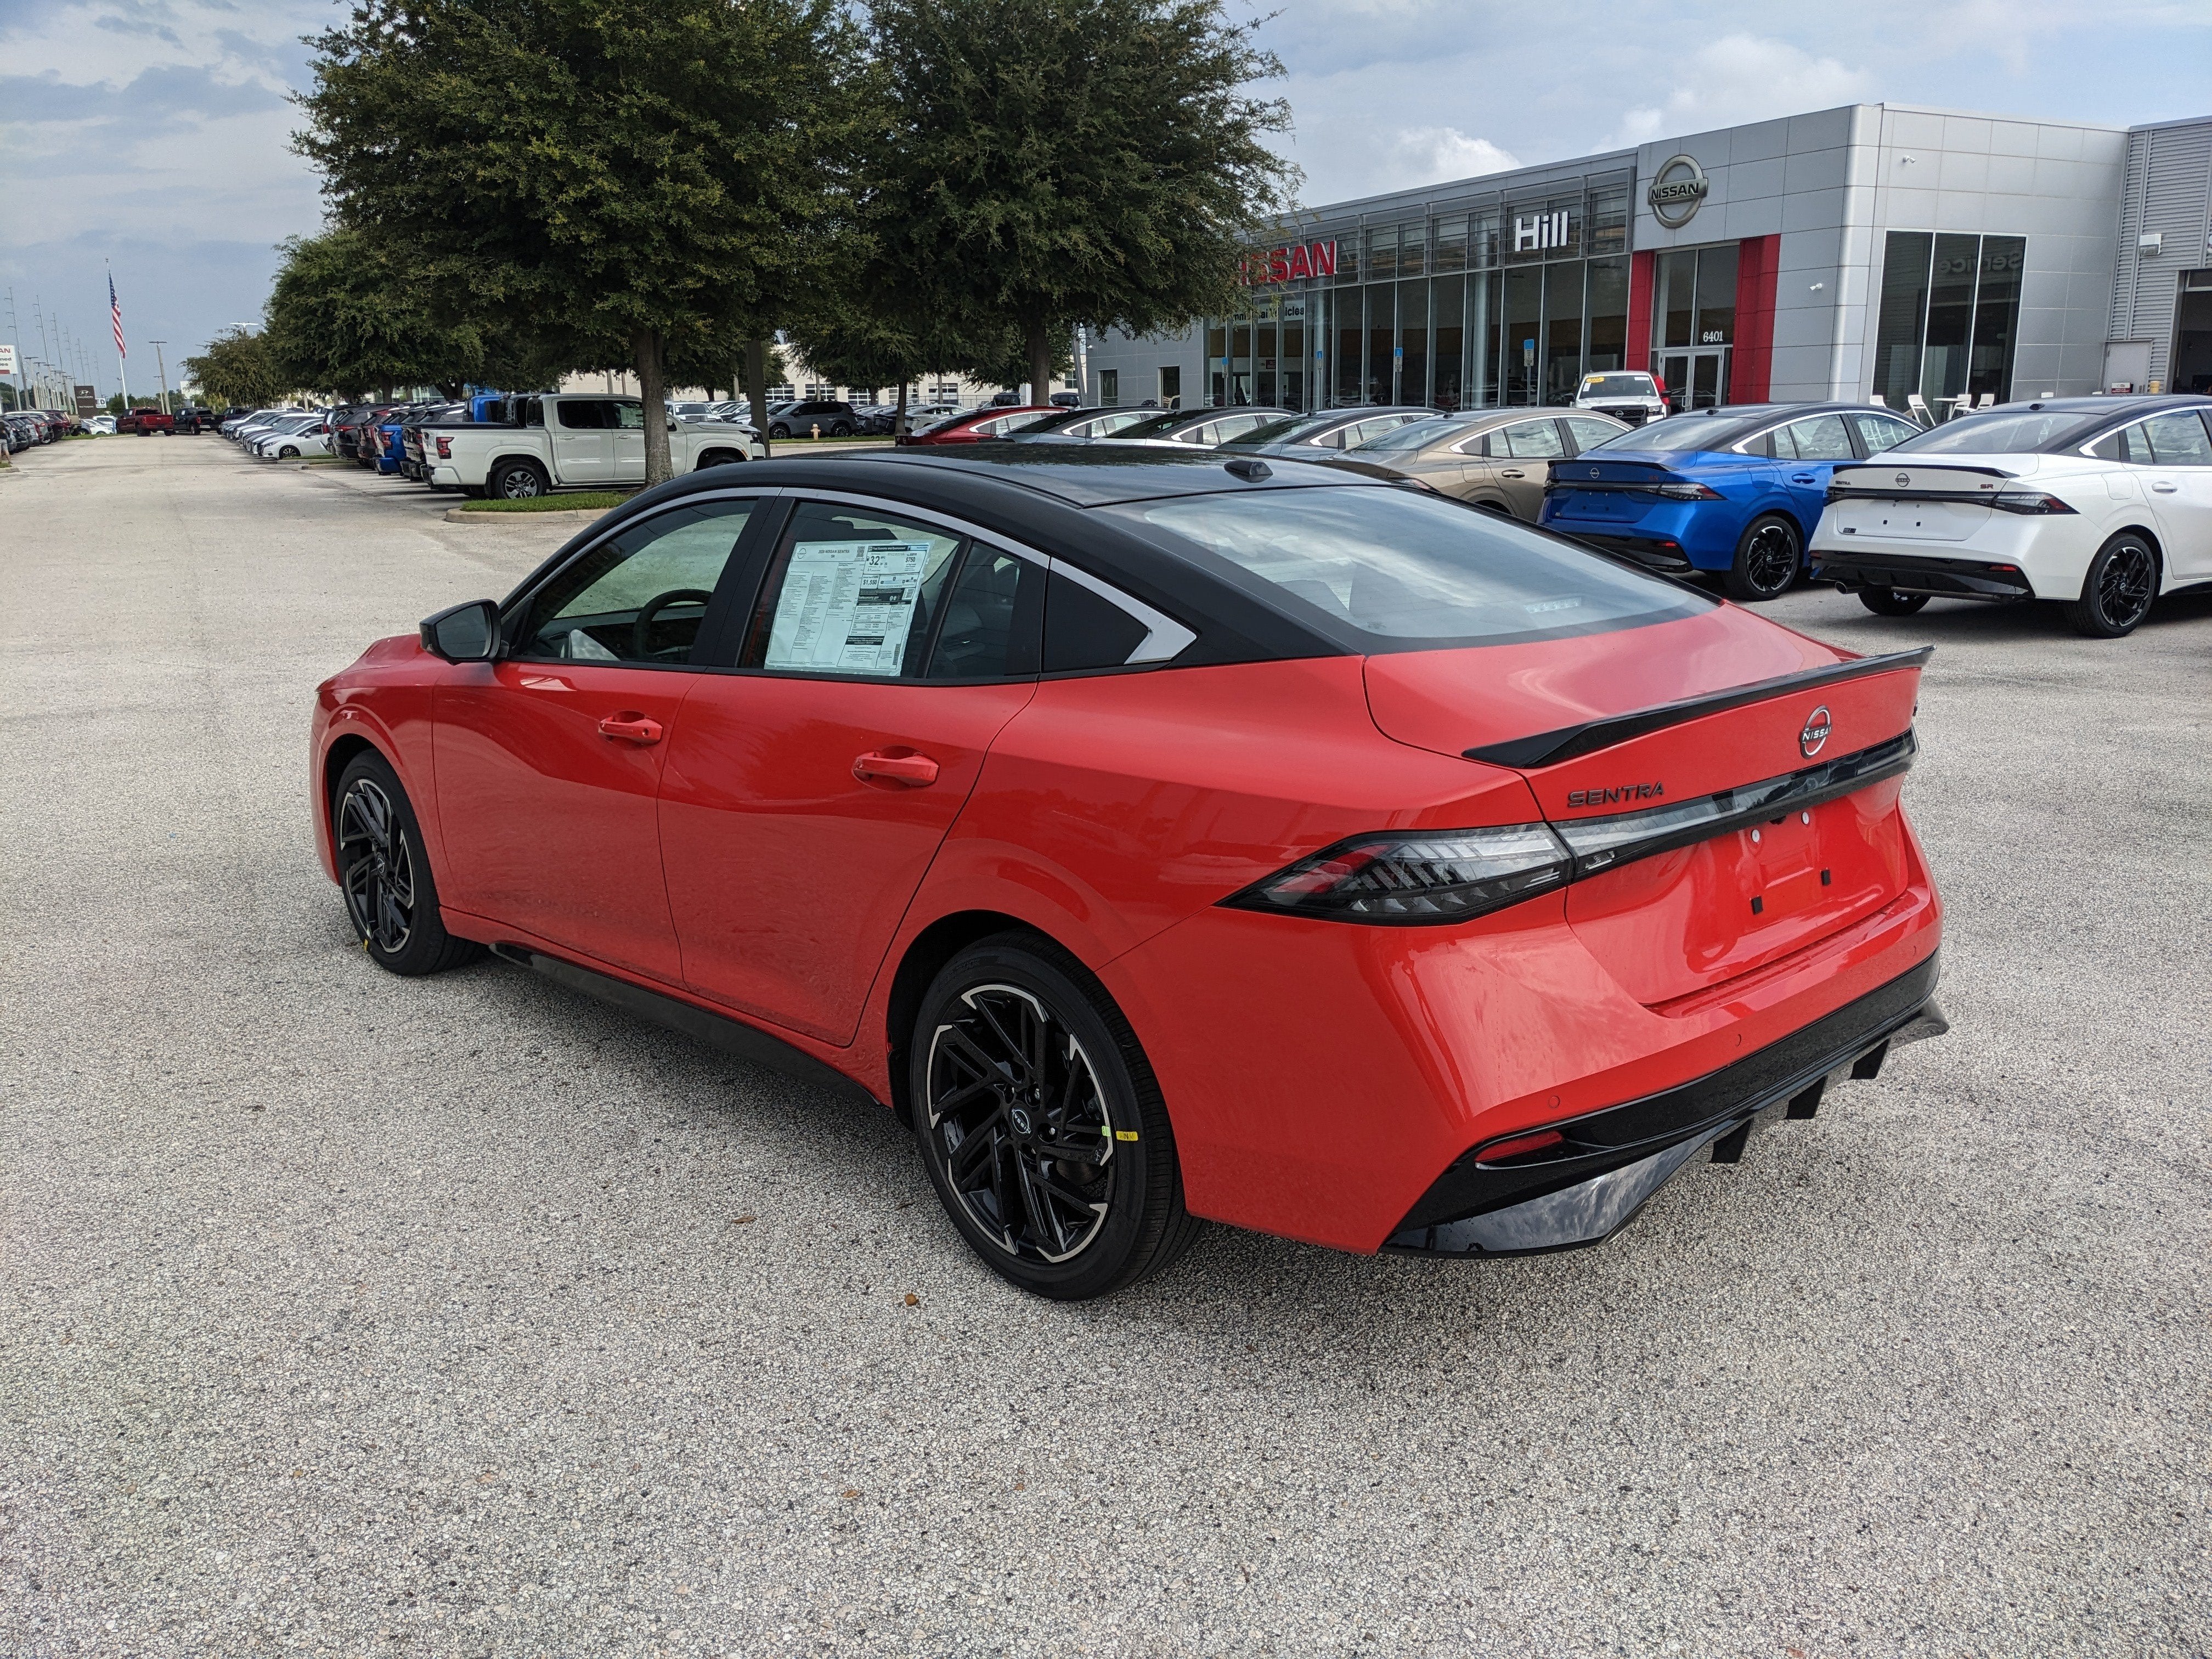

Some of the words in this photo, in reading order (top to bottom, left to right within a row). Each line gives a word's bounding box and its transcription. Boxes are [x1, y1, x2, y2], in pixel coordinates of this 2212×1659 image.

[1651, 183, 1699, 200] NISSAN
[1515, 211, 1570, 252] Hill
[1240, 240, 1338, 286] ISSAN
[1703, 330, 1723, 342] 6401
[869, 556, 880, 565] 32
[1568, 781, 1663, 807] SENTRA
